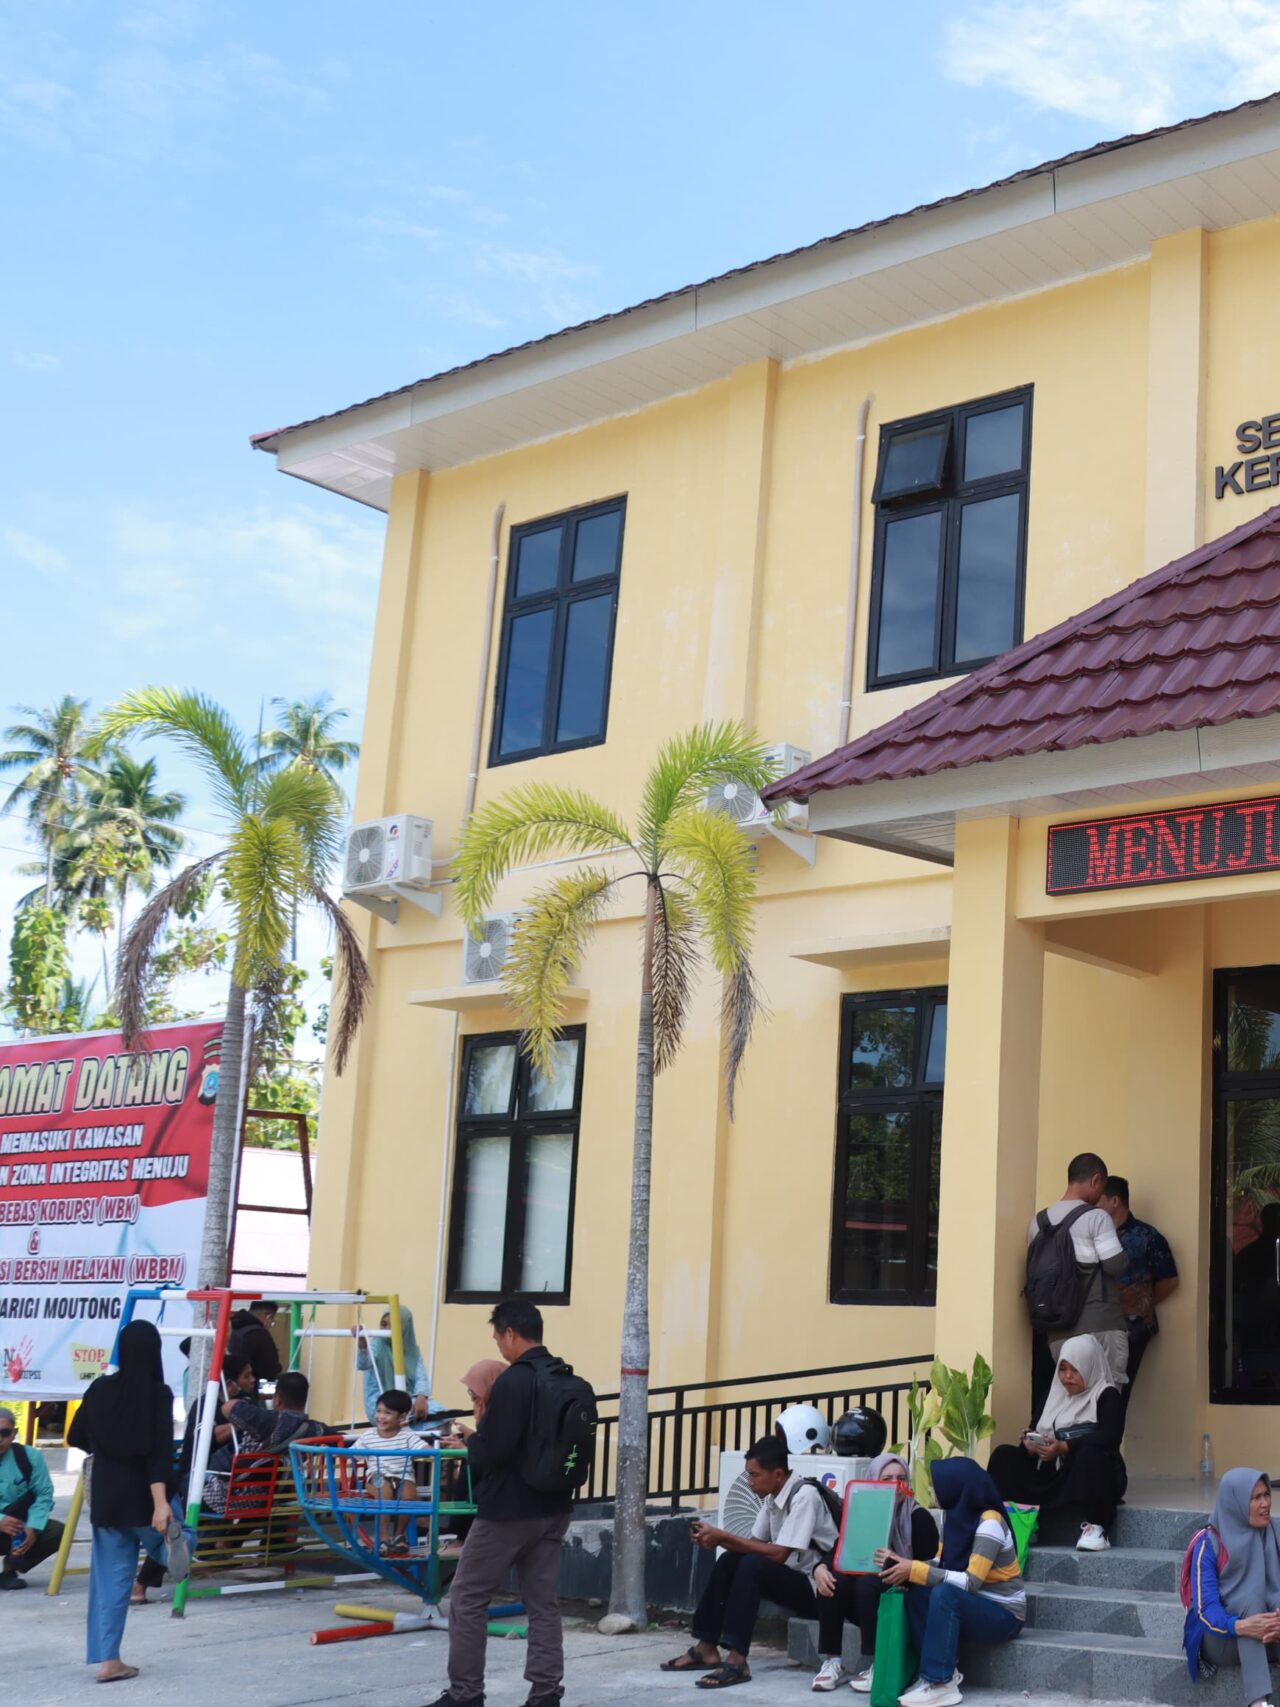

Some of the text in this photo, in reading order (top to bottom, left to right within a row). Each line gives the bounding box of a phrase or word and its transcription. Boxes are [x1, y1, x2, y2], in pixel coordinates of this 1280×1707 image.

[74, 1048, 189, 1111] DATANG
[1, 1125, 144, 1153] MEMASUKI KAWASAN
[11, 1163, 47, 1185] ZONA
[50, 1159, 129, 1183] INTEGRITAS
[131, 1155, 189, 1179] MENUJU
[39, 1199, 96, 1221] KORUPSI
[98, 1196, 139, 1223] (WBK)
[29, 1230, 39, 1252] &
[14, 1259, 59, 1282] BERSIH
[62, 1257, 125, 1281] MELAYANI
[129, 1255, 186, 1283] (WBBM)
[43, 1296, 121, 1319] MOUTONG
[73, 1349, 105, 1362] STOP
